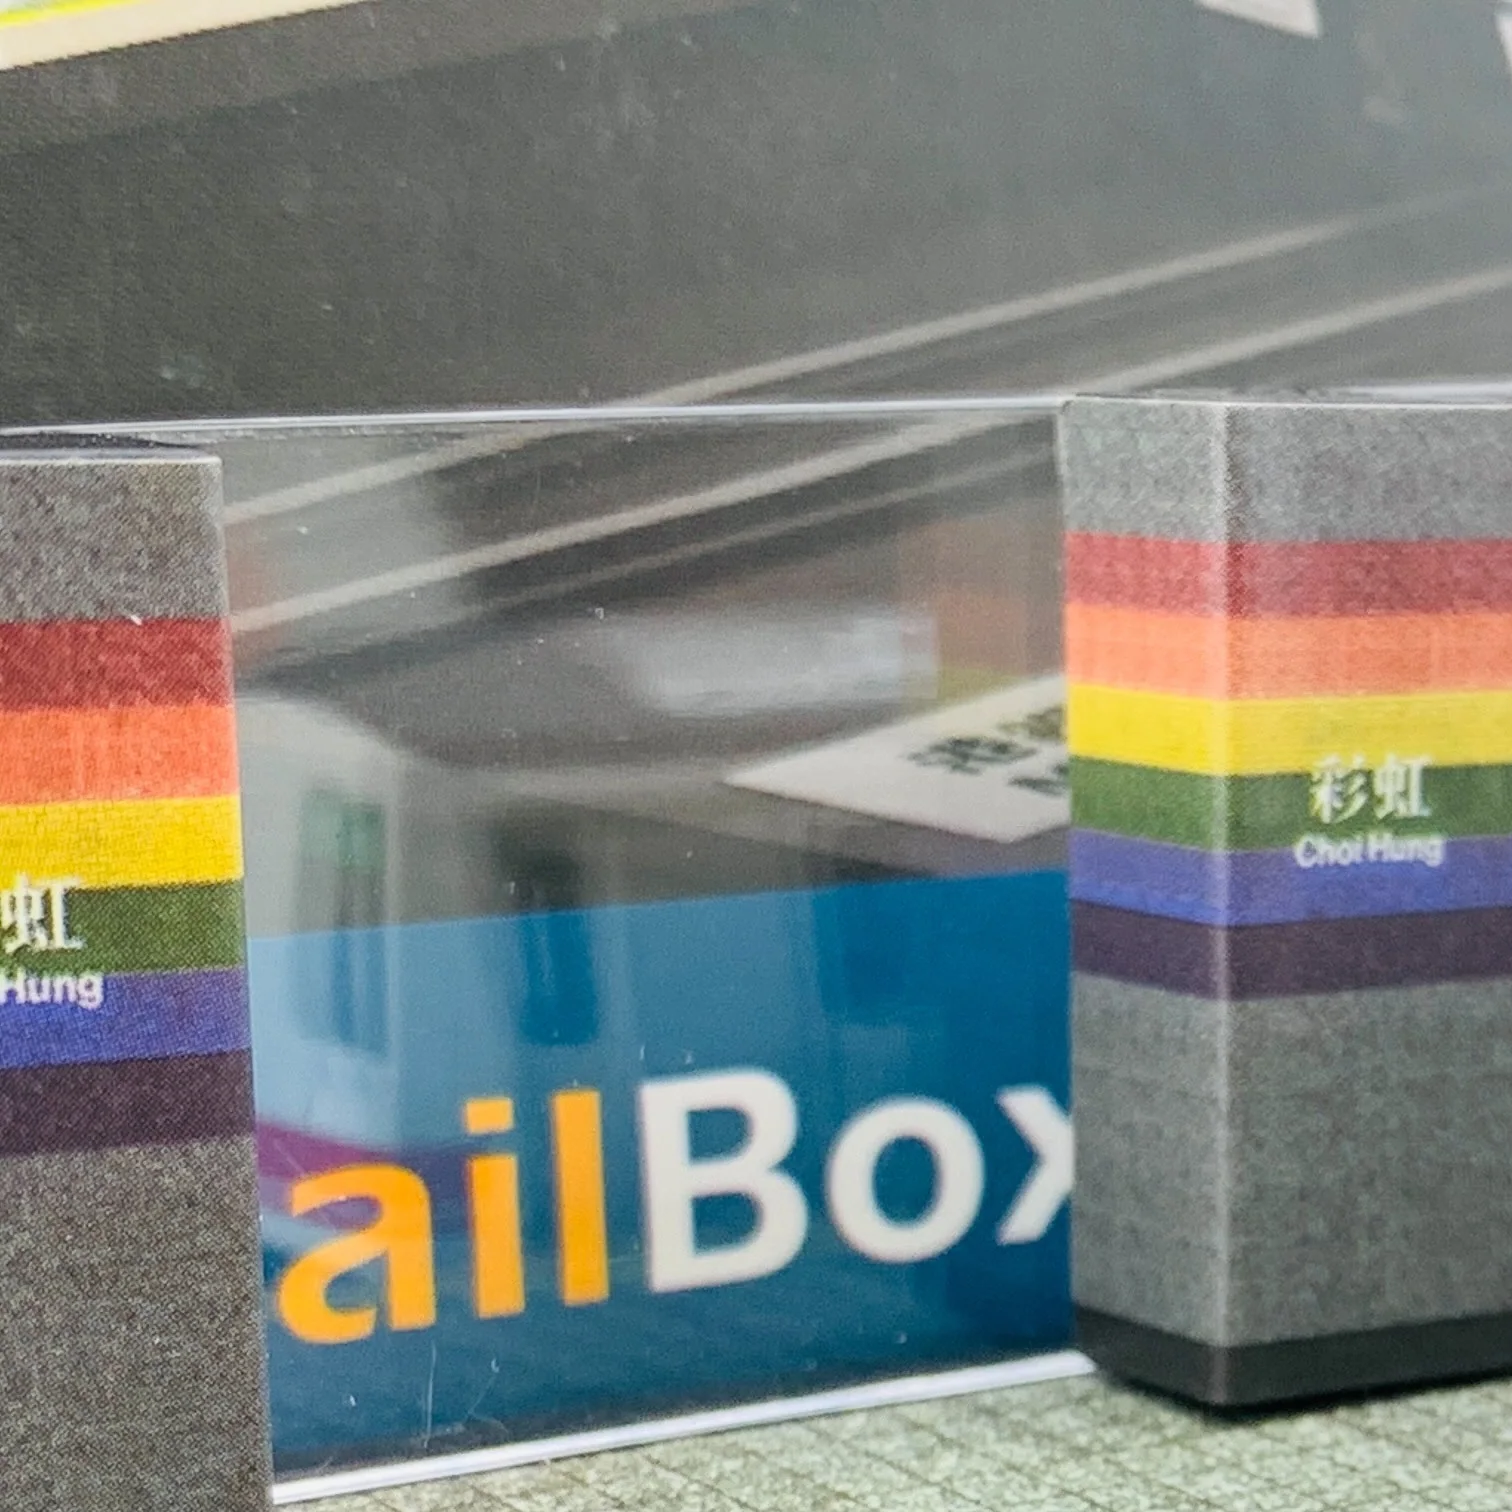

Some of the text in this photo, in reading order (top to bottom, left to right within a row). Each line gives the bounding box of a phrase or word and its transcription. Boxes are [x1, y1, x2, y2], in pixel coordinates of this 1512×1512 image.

[1309, 752, 1433, 824] 彩虹
[1293, 829, 1447, 868] Choi Hung
[0, 966, 104, 1010] Hung
